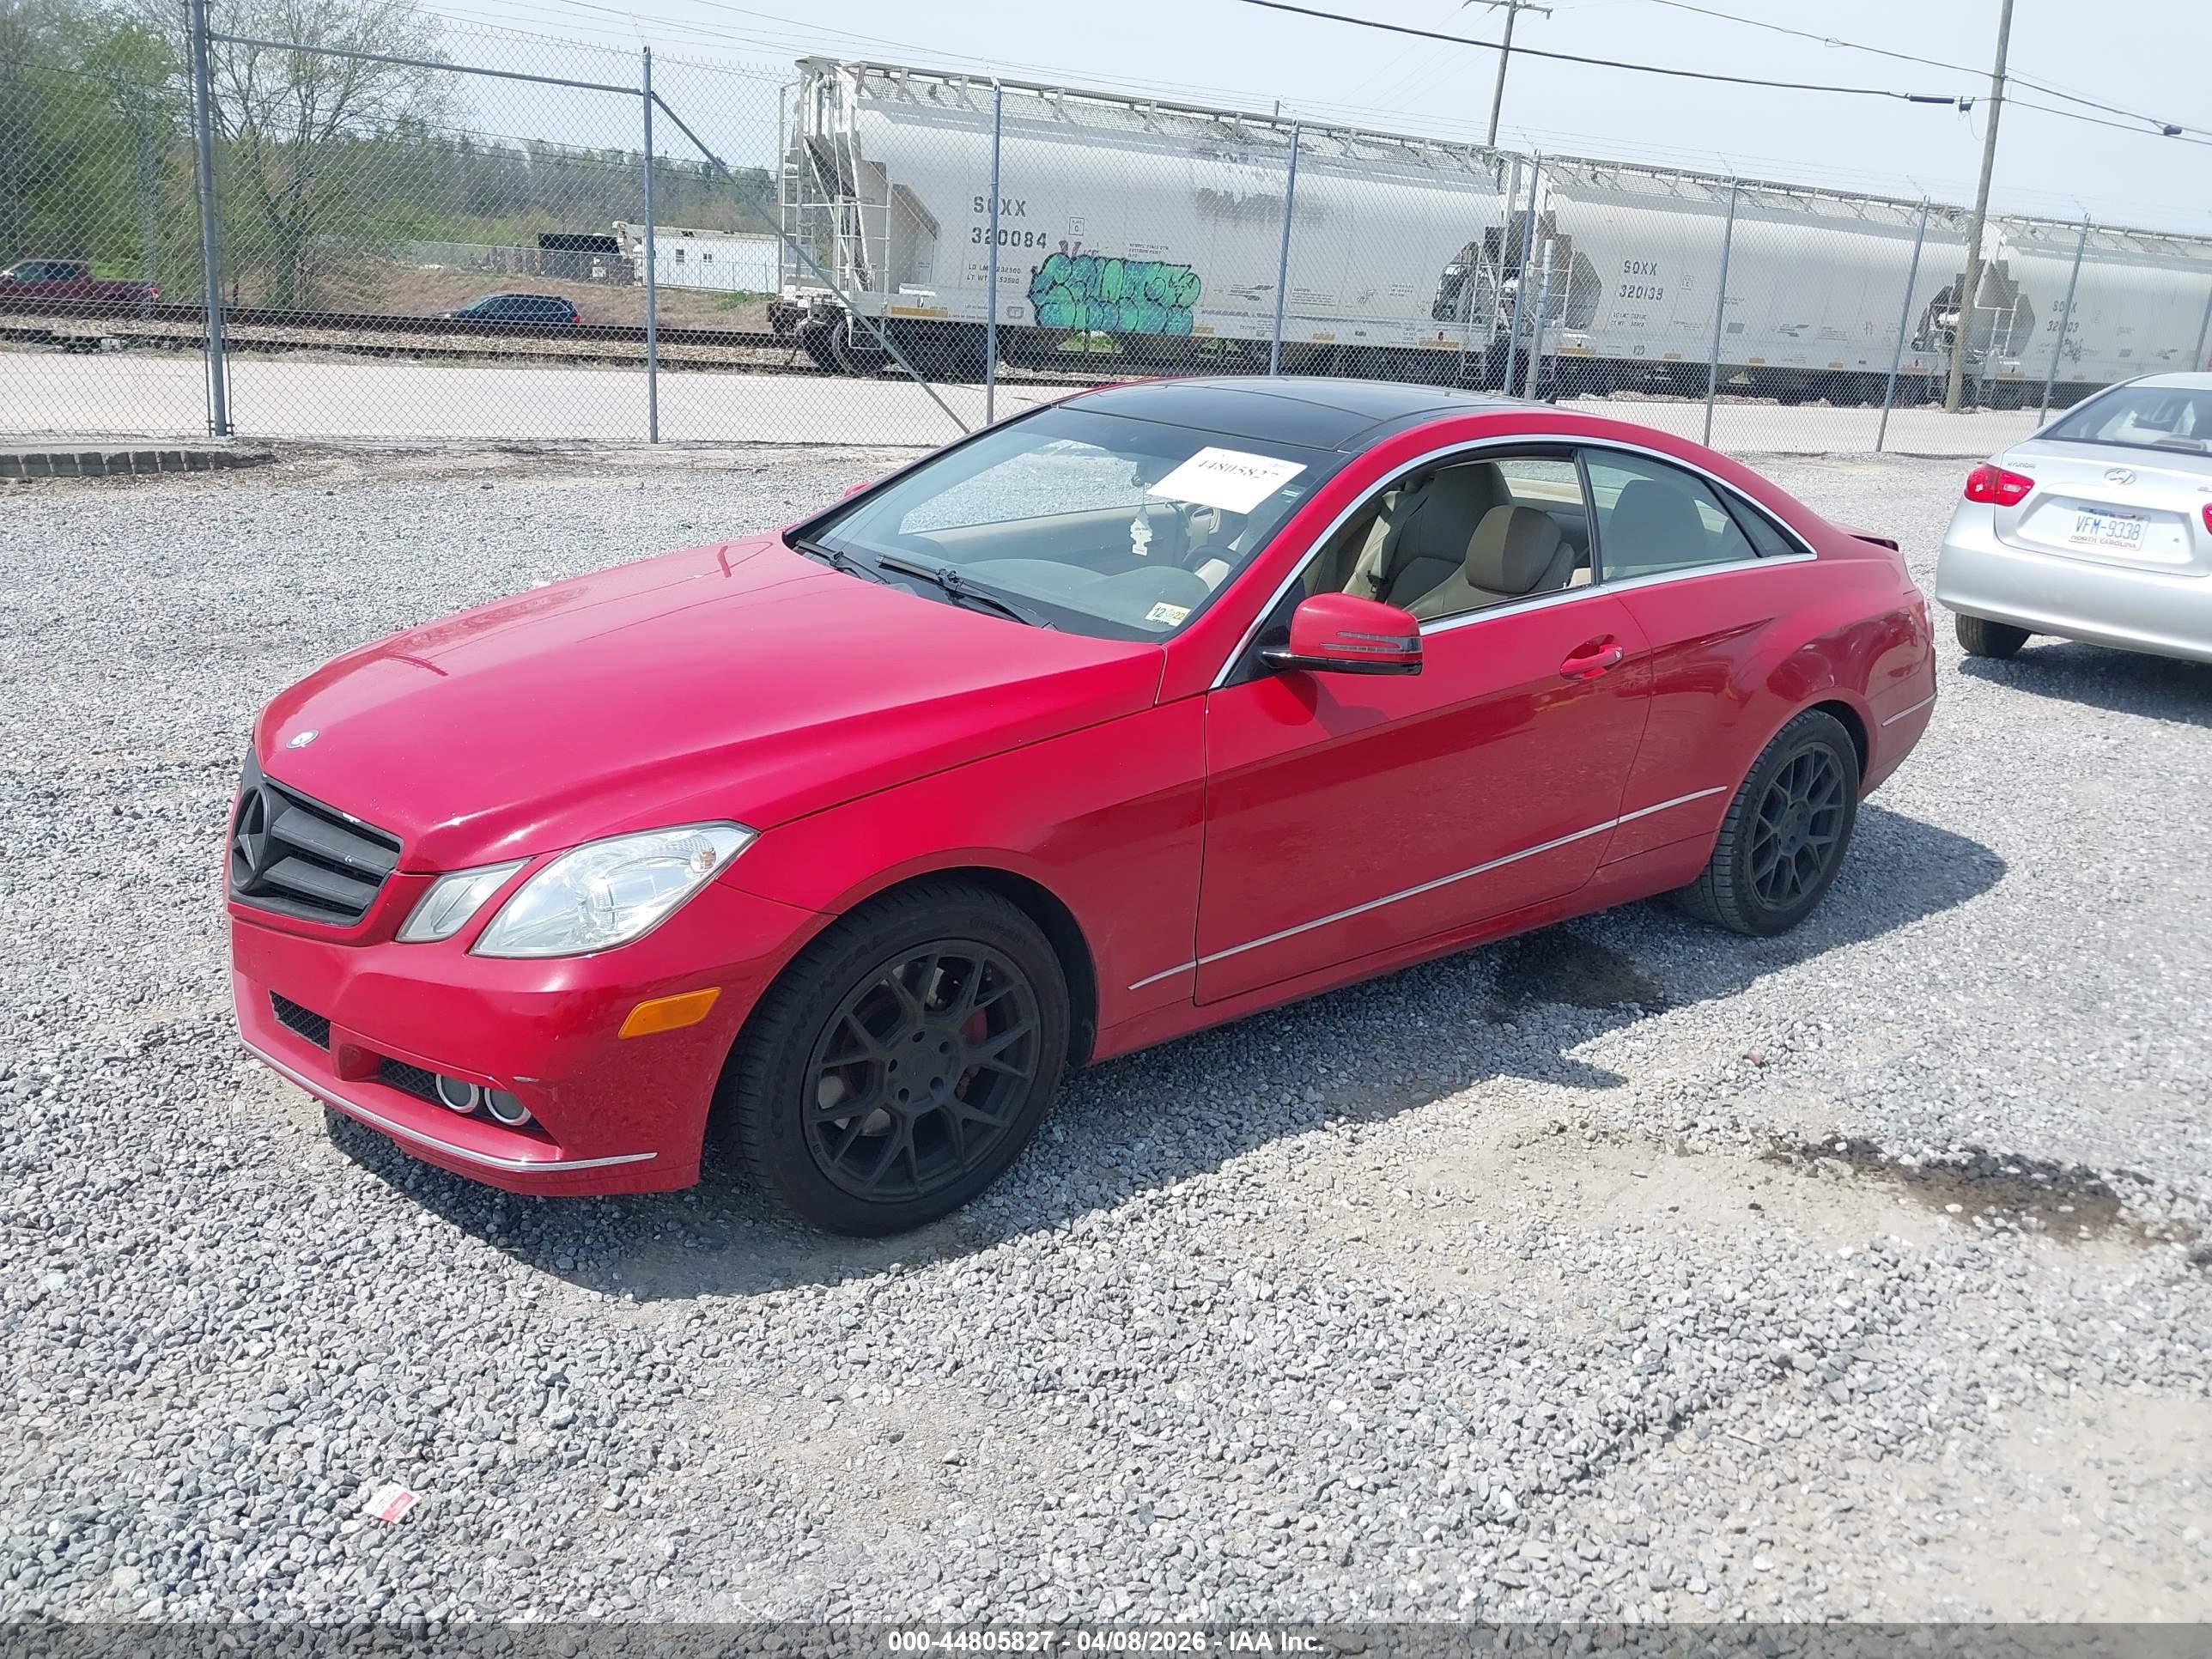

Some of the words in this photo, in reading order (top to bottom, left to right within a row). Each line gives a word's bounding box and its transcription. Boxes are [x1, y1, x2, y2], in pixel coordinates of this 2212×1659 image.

[971, 227, 1047, 249] 320084
[1623, 259, 1657, 276] SOXX
[2052, 301, 2078, 313] SOX
[2046, 319, 2080, 333] 3203
[2075, 514, 2142, 541] VFM-9338
[1152, 606, 1167, 618] 12
